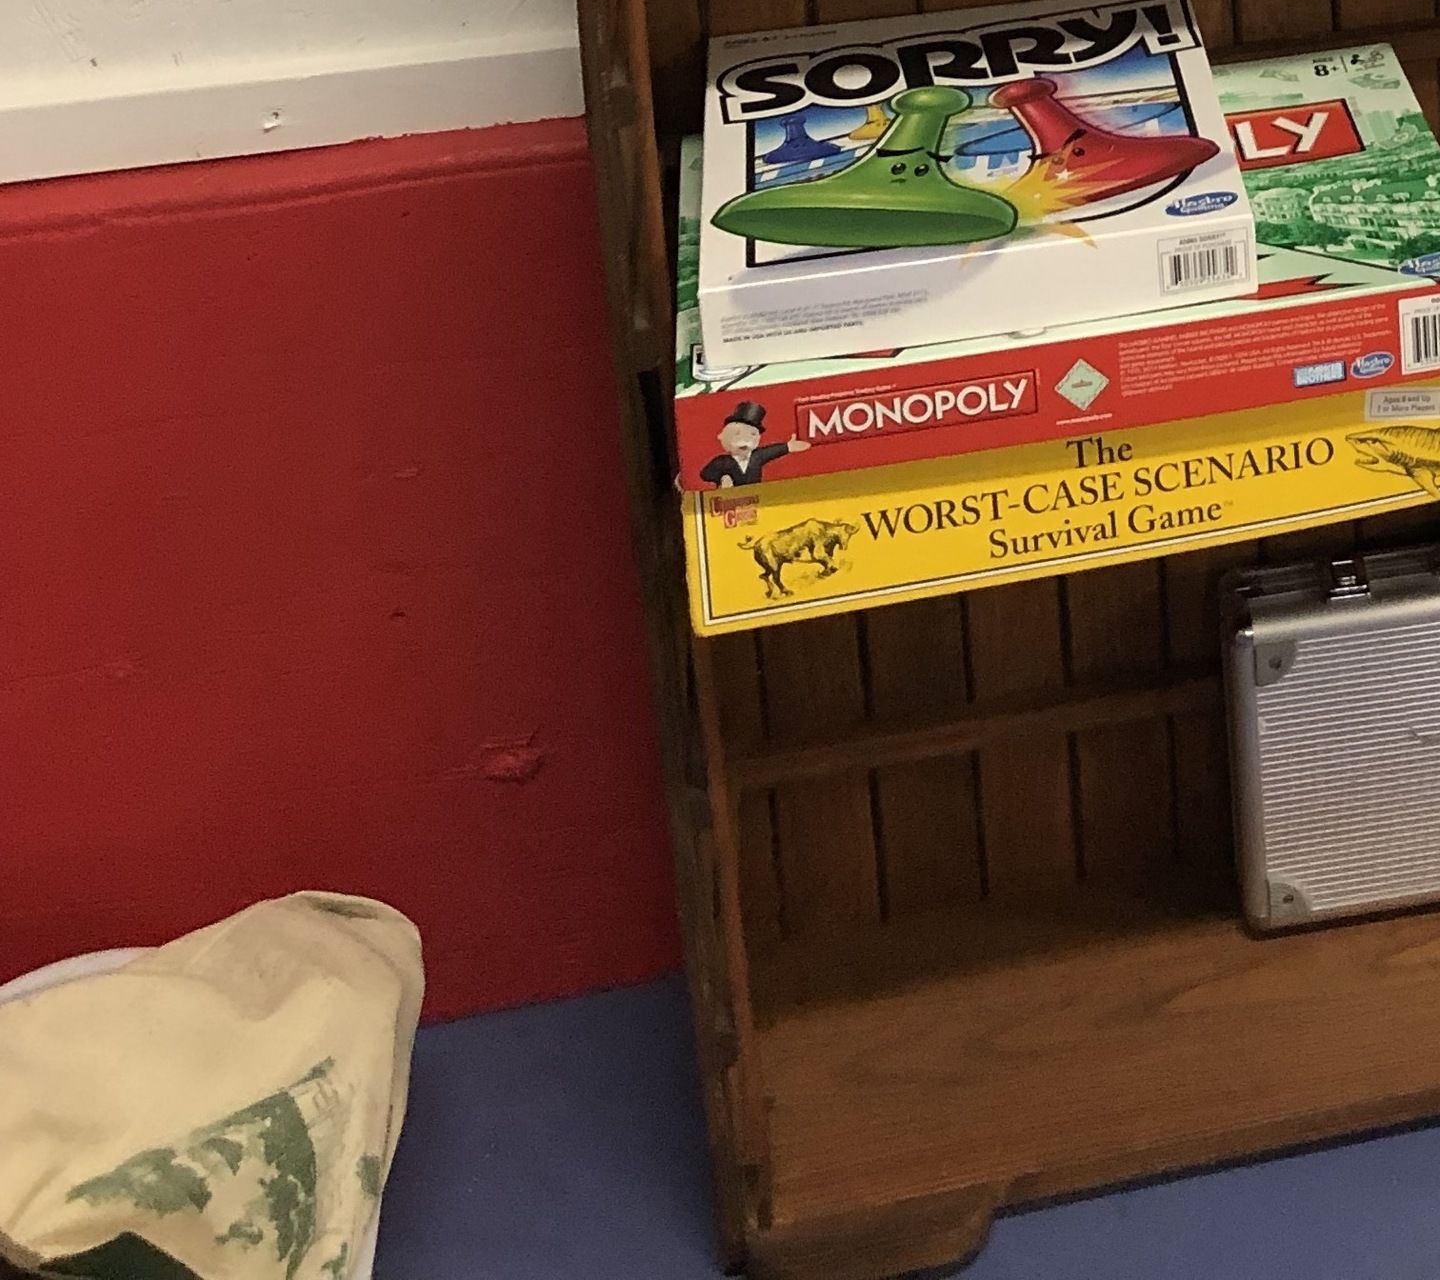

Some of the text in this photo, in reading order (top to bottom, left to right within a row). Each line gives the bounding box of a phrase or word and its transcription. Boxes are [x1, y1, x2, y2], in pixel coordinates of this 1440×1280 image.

[735, 3, 1183, 114] SORRY!
[1173, 195, 1233, 209] Hasbro
[808, 378, 1029, 439] MONOPOLY
[1067, 437, 1133, 470] The
[861, 436, 1335, 542] WORST-CASE SCENARIO
[989, 509, 1119, 560] Survival
